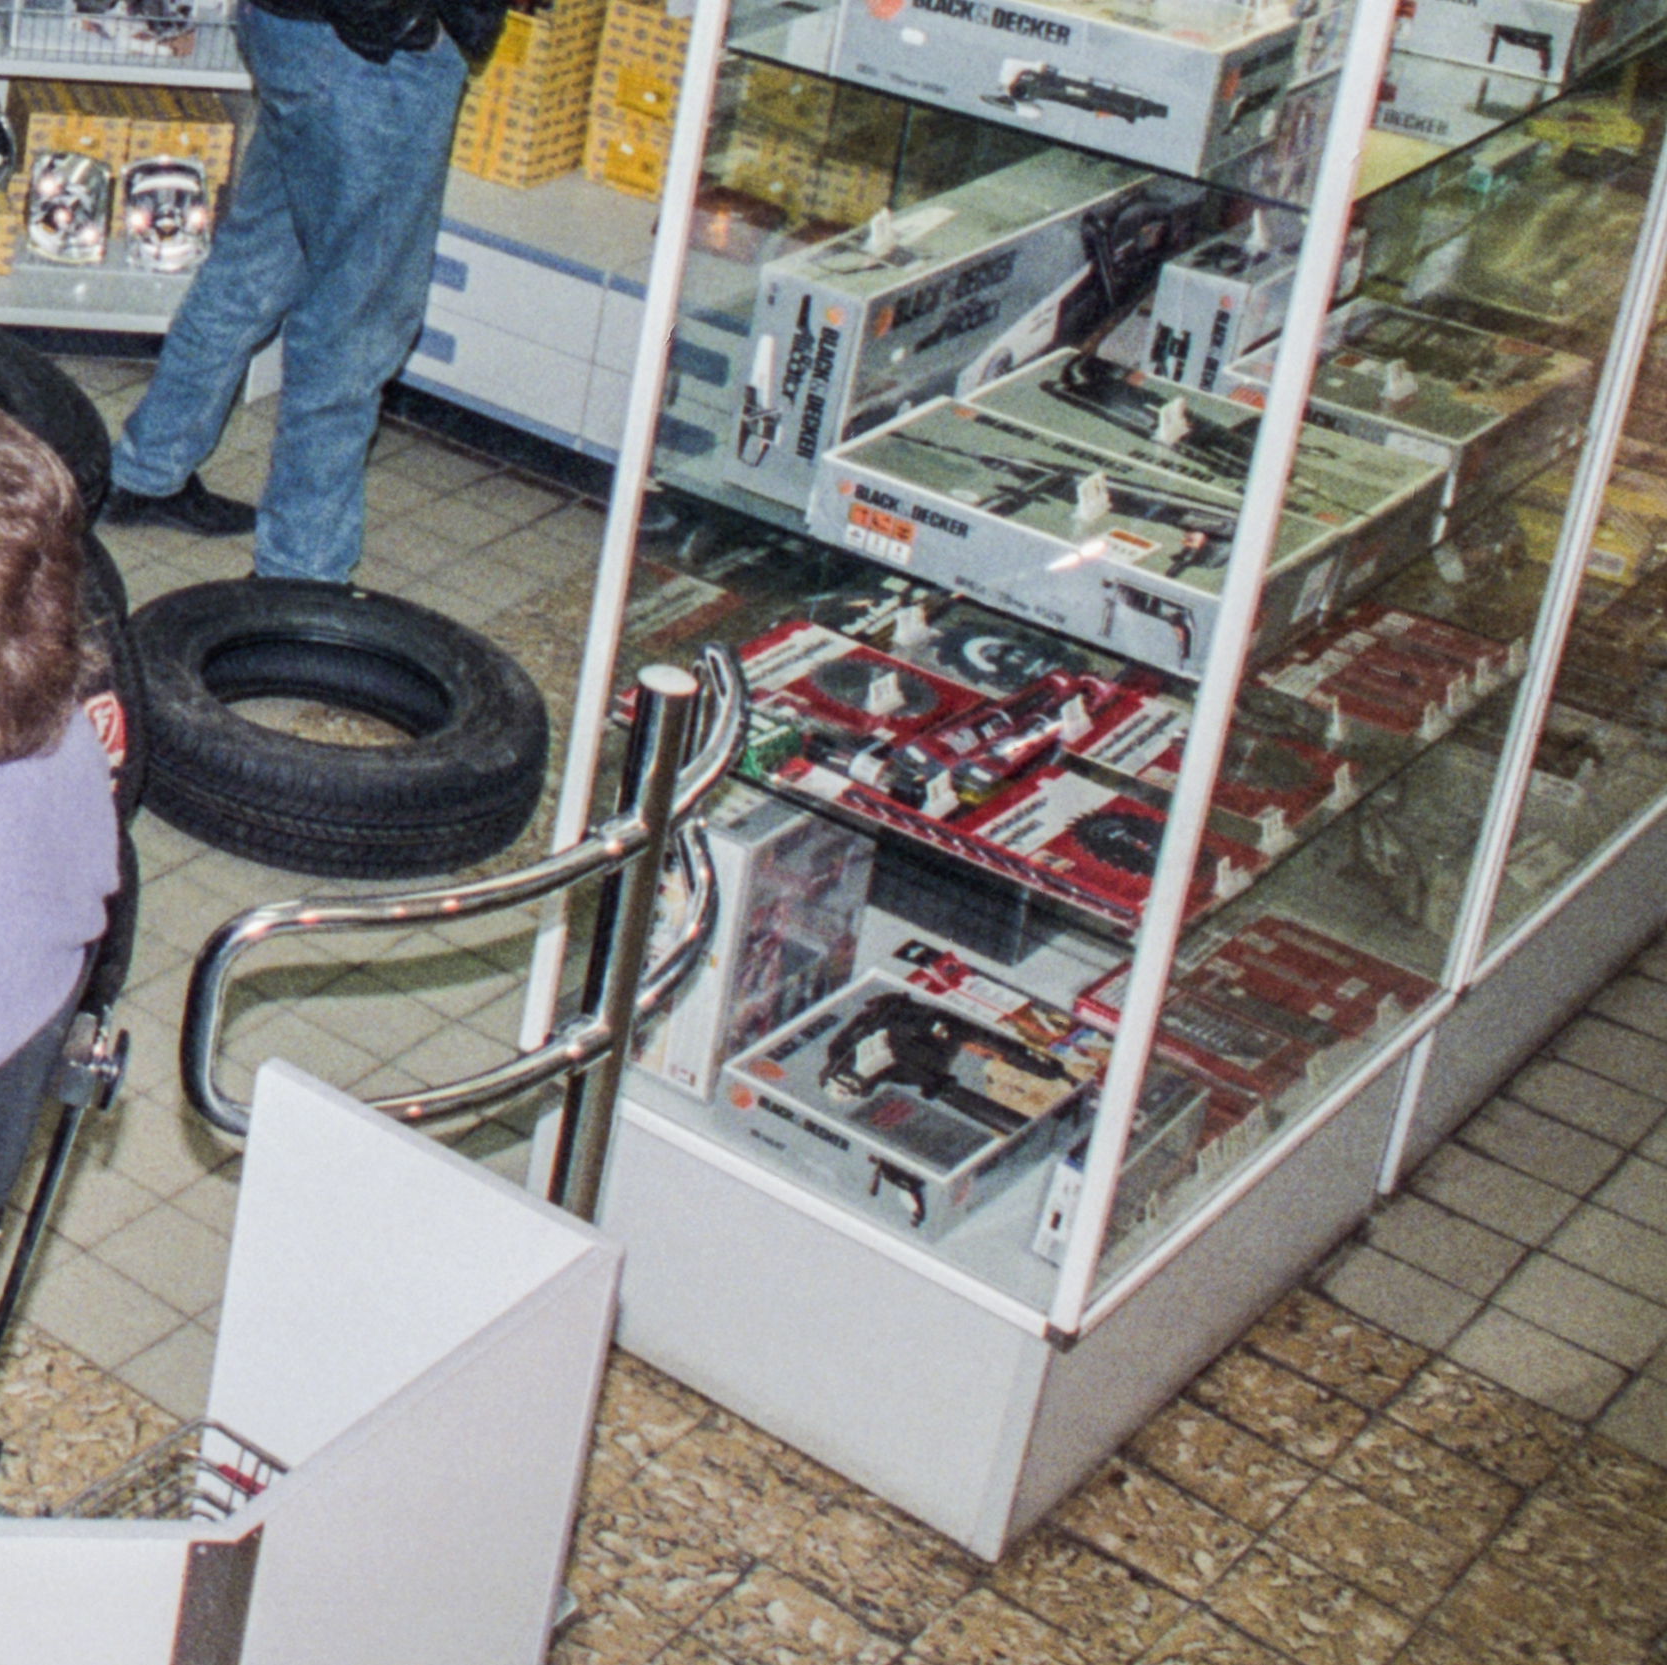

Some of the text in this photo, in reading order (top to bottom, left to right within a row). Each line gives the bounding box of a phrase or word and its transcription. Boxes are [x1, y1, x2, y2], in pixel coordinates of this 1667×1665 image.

[975, 3, 991, 25] &
[991, 7, 1072, 46] DECKER
[813, 326, 840, 383] BLACK
[796, 392, 825, 461] DECKER
[854, 483, 969, 538] BLACK DECKER
